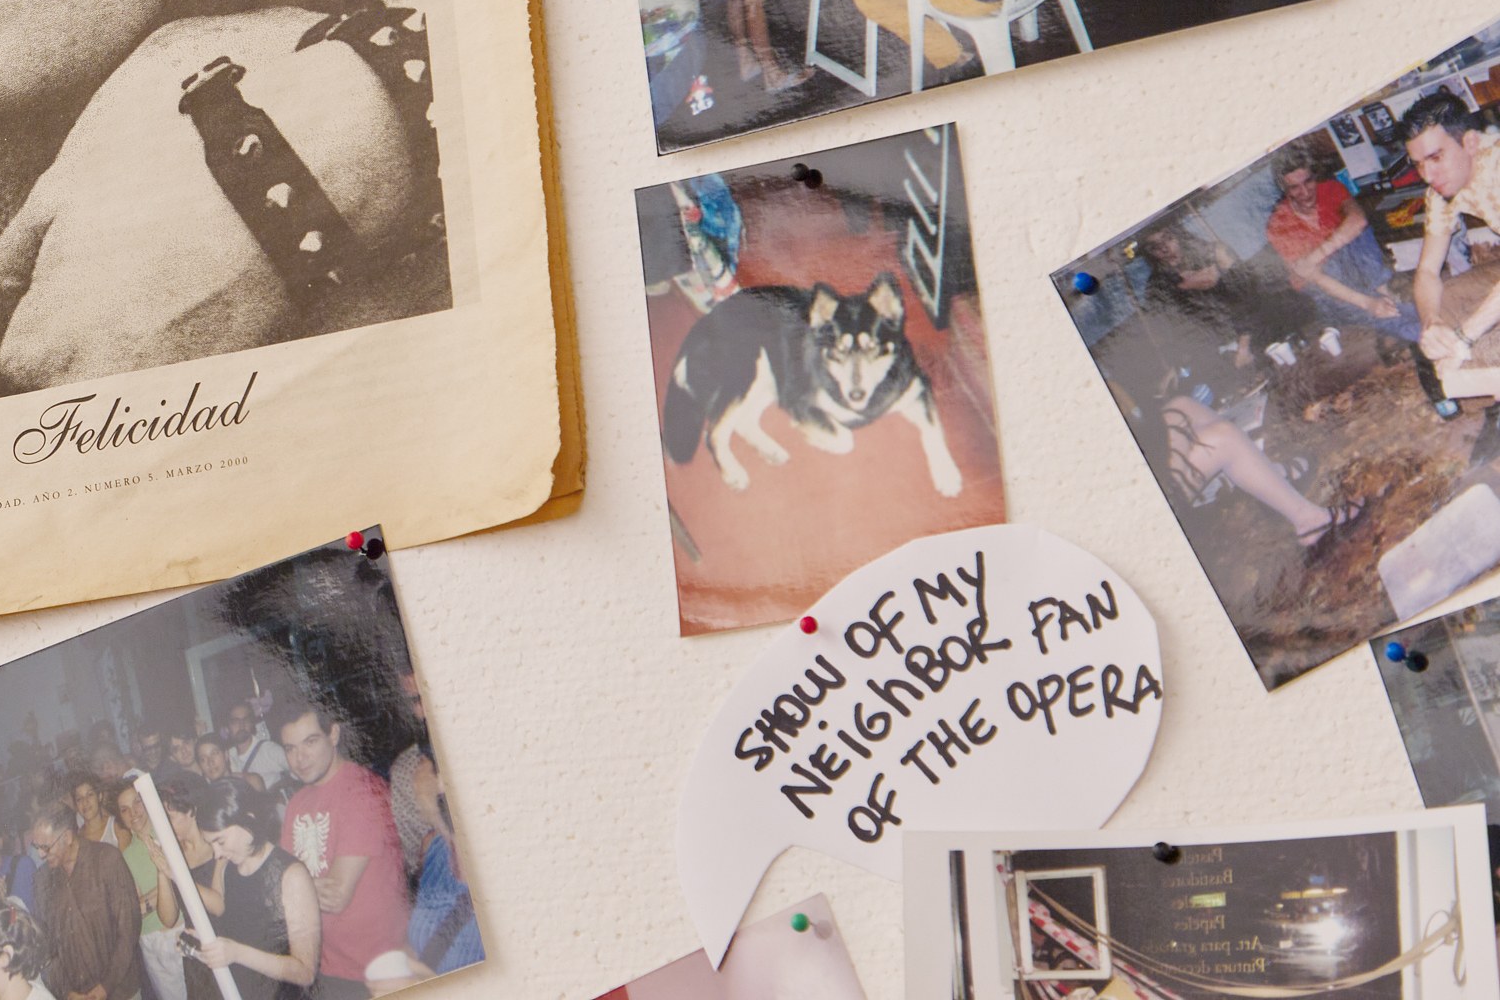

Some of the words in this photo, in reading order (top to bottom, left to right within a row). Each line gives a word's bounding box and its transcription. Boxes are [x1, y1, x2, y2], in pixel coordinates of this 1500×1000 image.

[12, 371, 259, 465] Felicidad
[32, 488, 62, 505] AÑO
[83, 474, 143, 495] NUMERO
[165, 462, 216, 480] MARZO
[219, 456, 250, 470] 2000
[735, 654, 846, 771] SHOW
[844, 592, 905, 658] OF
[913, 551, 986, 624] MY
[1029, 581, 1119, 654] FAN
[848, 776, 904, 844] OF
[901, 698, 998, 786] THE
[1006, 662, 1163, 735] OPERA
